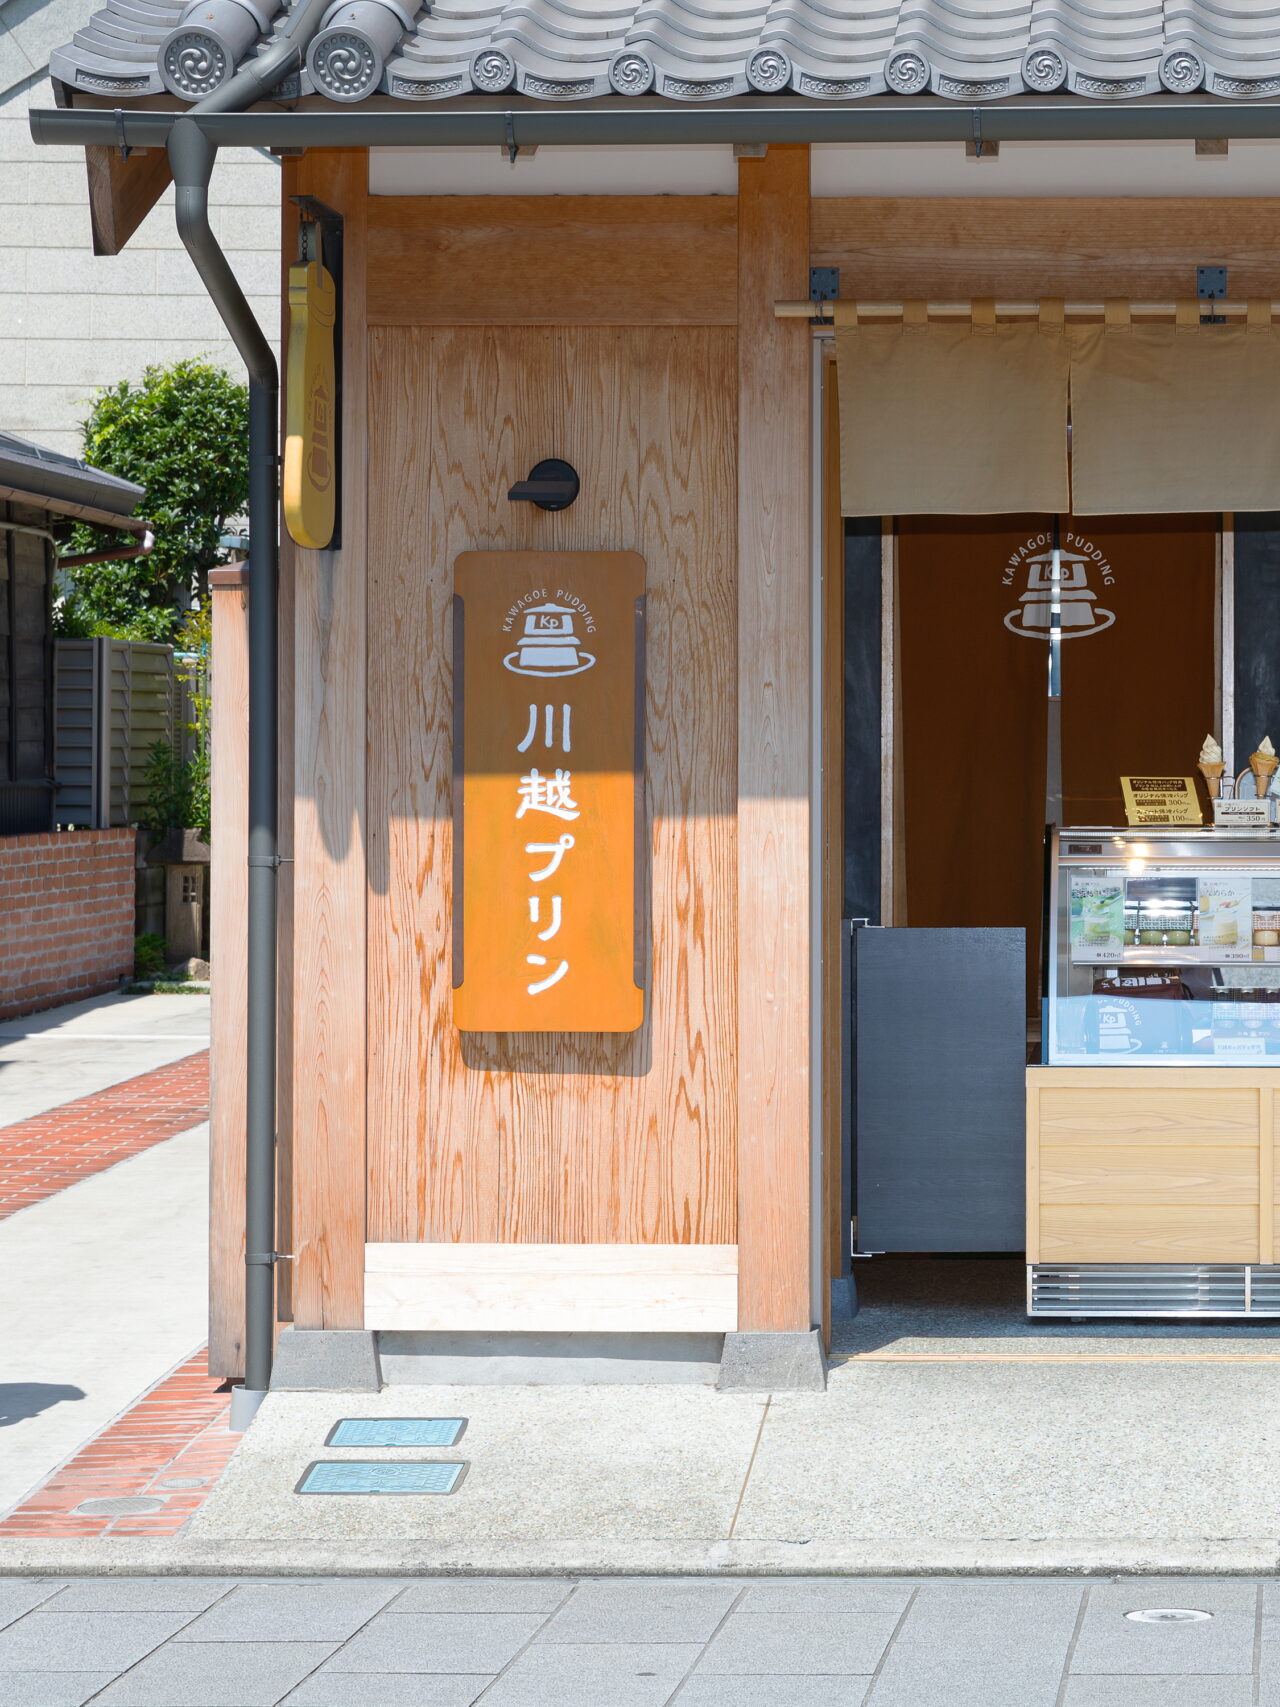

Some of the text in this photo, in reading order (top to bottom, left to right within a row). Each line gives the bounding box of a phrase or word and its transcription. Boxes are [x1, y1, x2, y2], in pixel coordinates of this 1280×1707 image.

[1002, 532, 1115, 585] KAWAGOE PUDDING
[502, 588, 597, 634] KAWAGOE PUDDING
[515, 703, 580, 995] 川越プリン
[1205, 889, 1235, 897] なめらか
